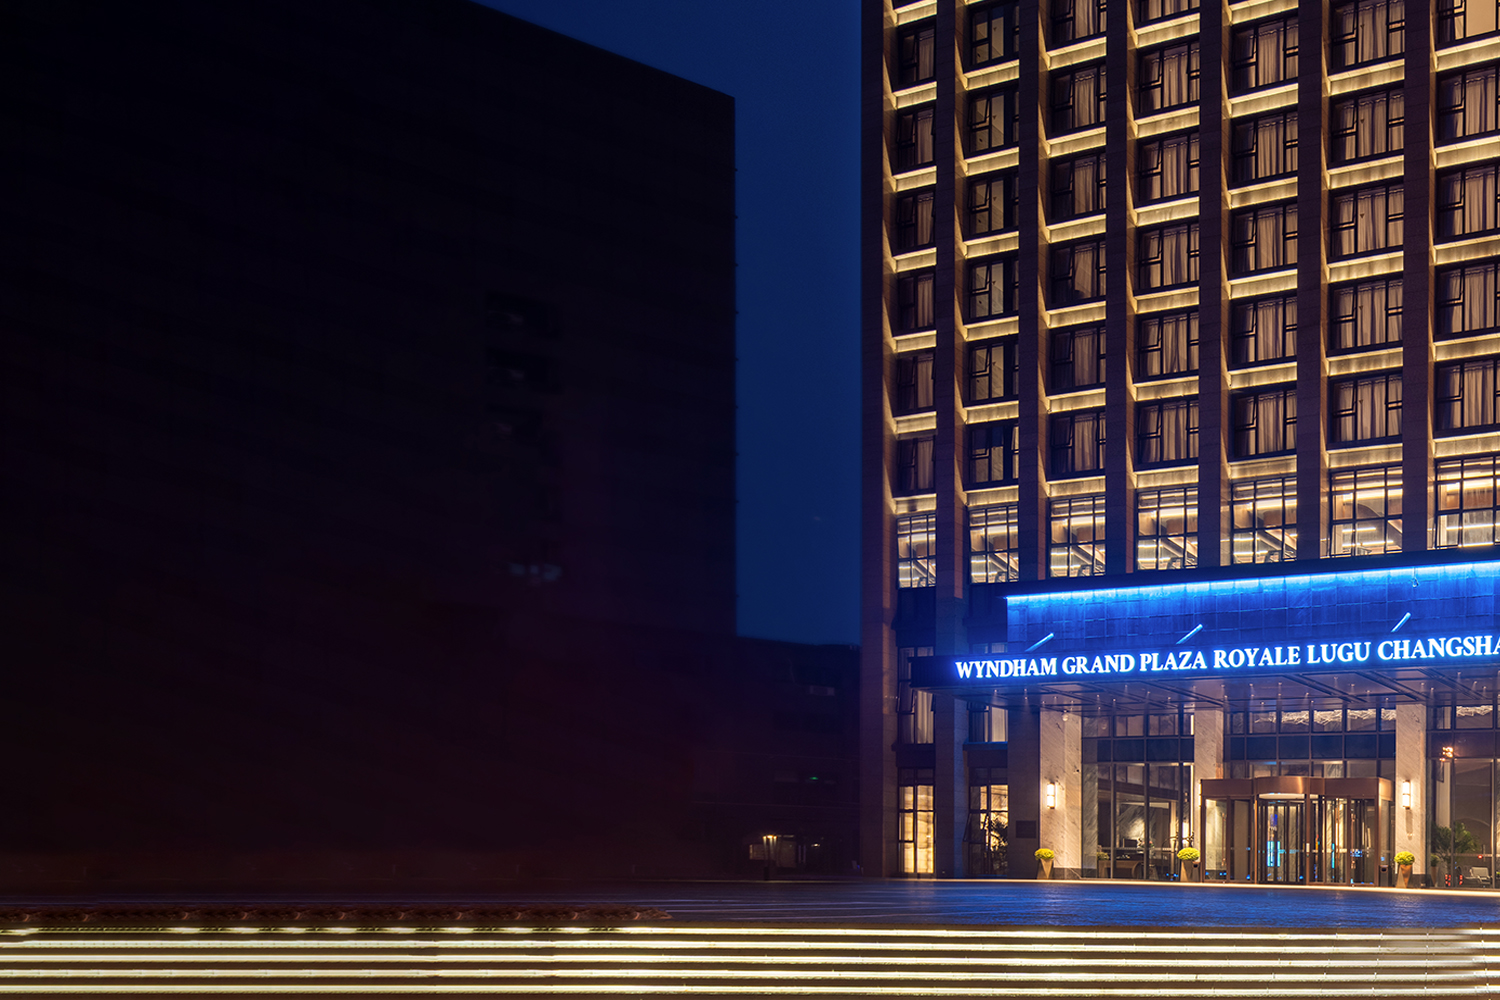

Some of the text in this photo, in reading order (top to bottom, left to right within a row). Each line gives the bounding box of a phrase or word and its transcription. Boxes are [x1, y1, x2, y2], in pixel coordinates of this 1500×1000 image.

[955, 657, 1058, 679] WYNDHAM
[1061, 654, 1134, 675] GRAND
[1139, 650, 1207, 672] PLAZA
[1213, 645, 1301, 669] ROYALE
[1306, 641, 1372, 664] LUGU
